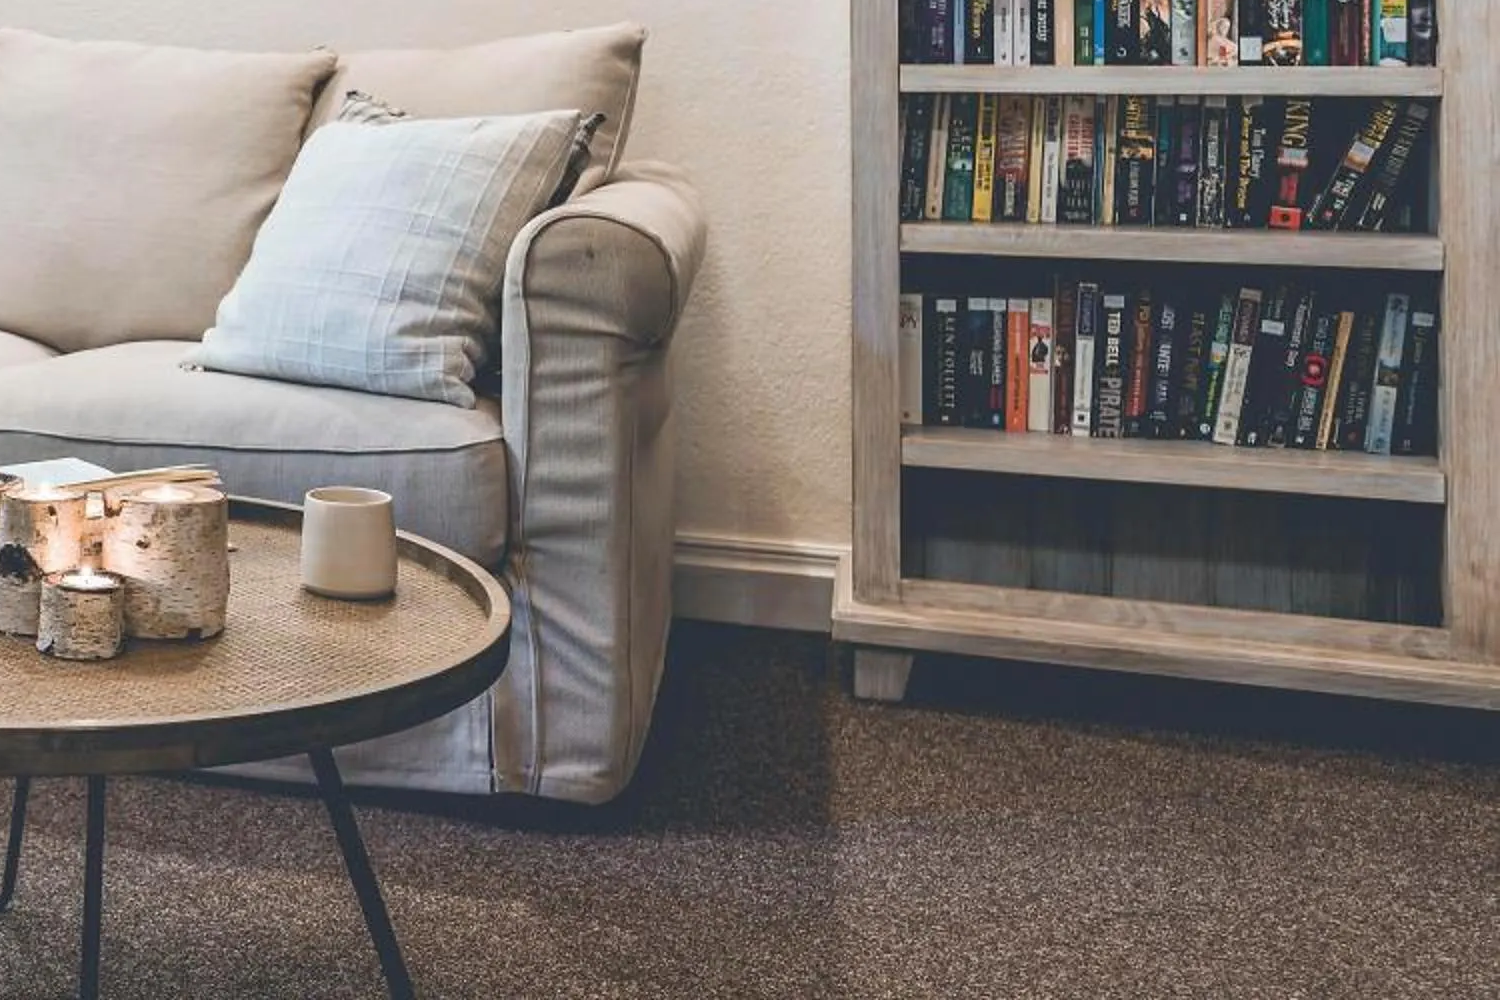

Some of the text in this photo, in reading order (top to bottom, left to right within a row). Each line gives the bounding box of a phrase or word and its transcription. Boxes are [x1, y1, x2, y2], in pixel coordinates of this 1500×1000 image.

[1281, 100, 1310, 147] KING
[1098, 312, 1122, 437] TED BELL PIRATE
